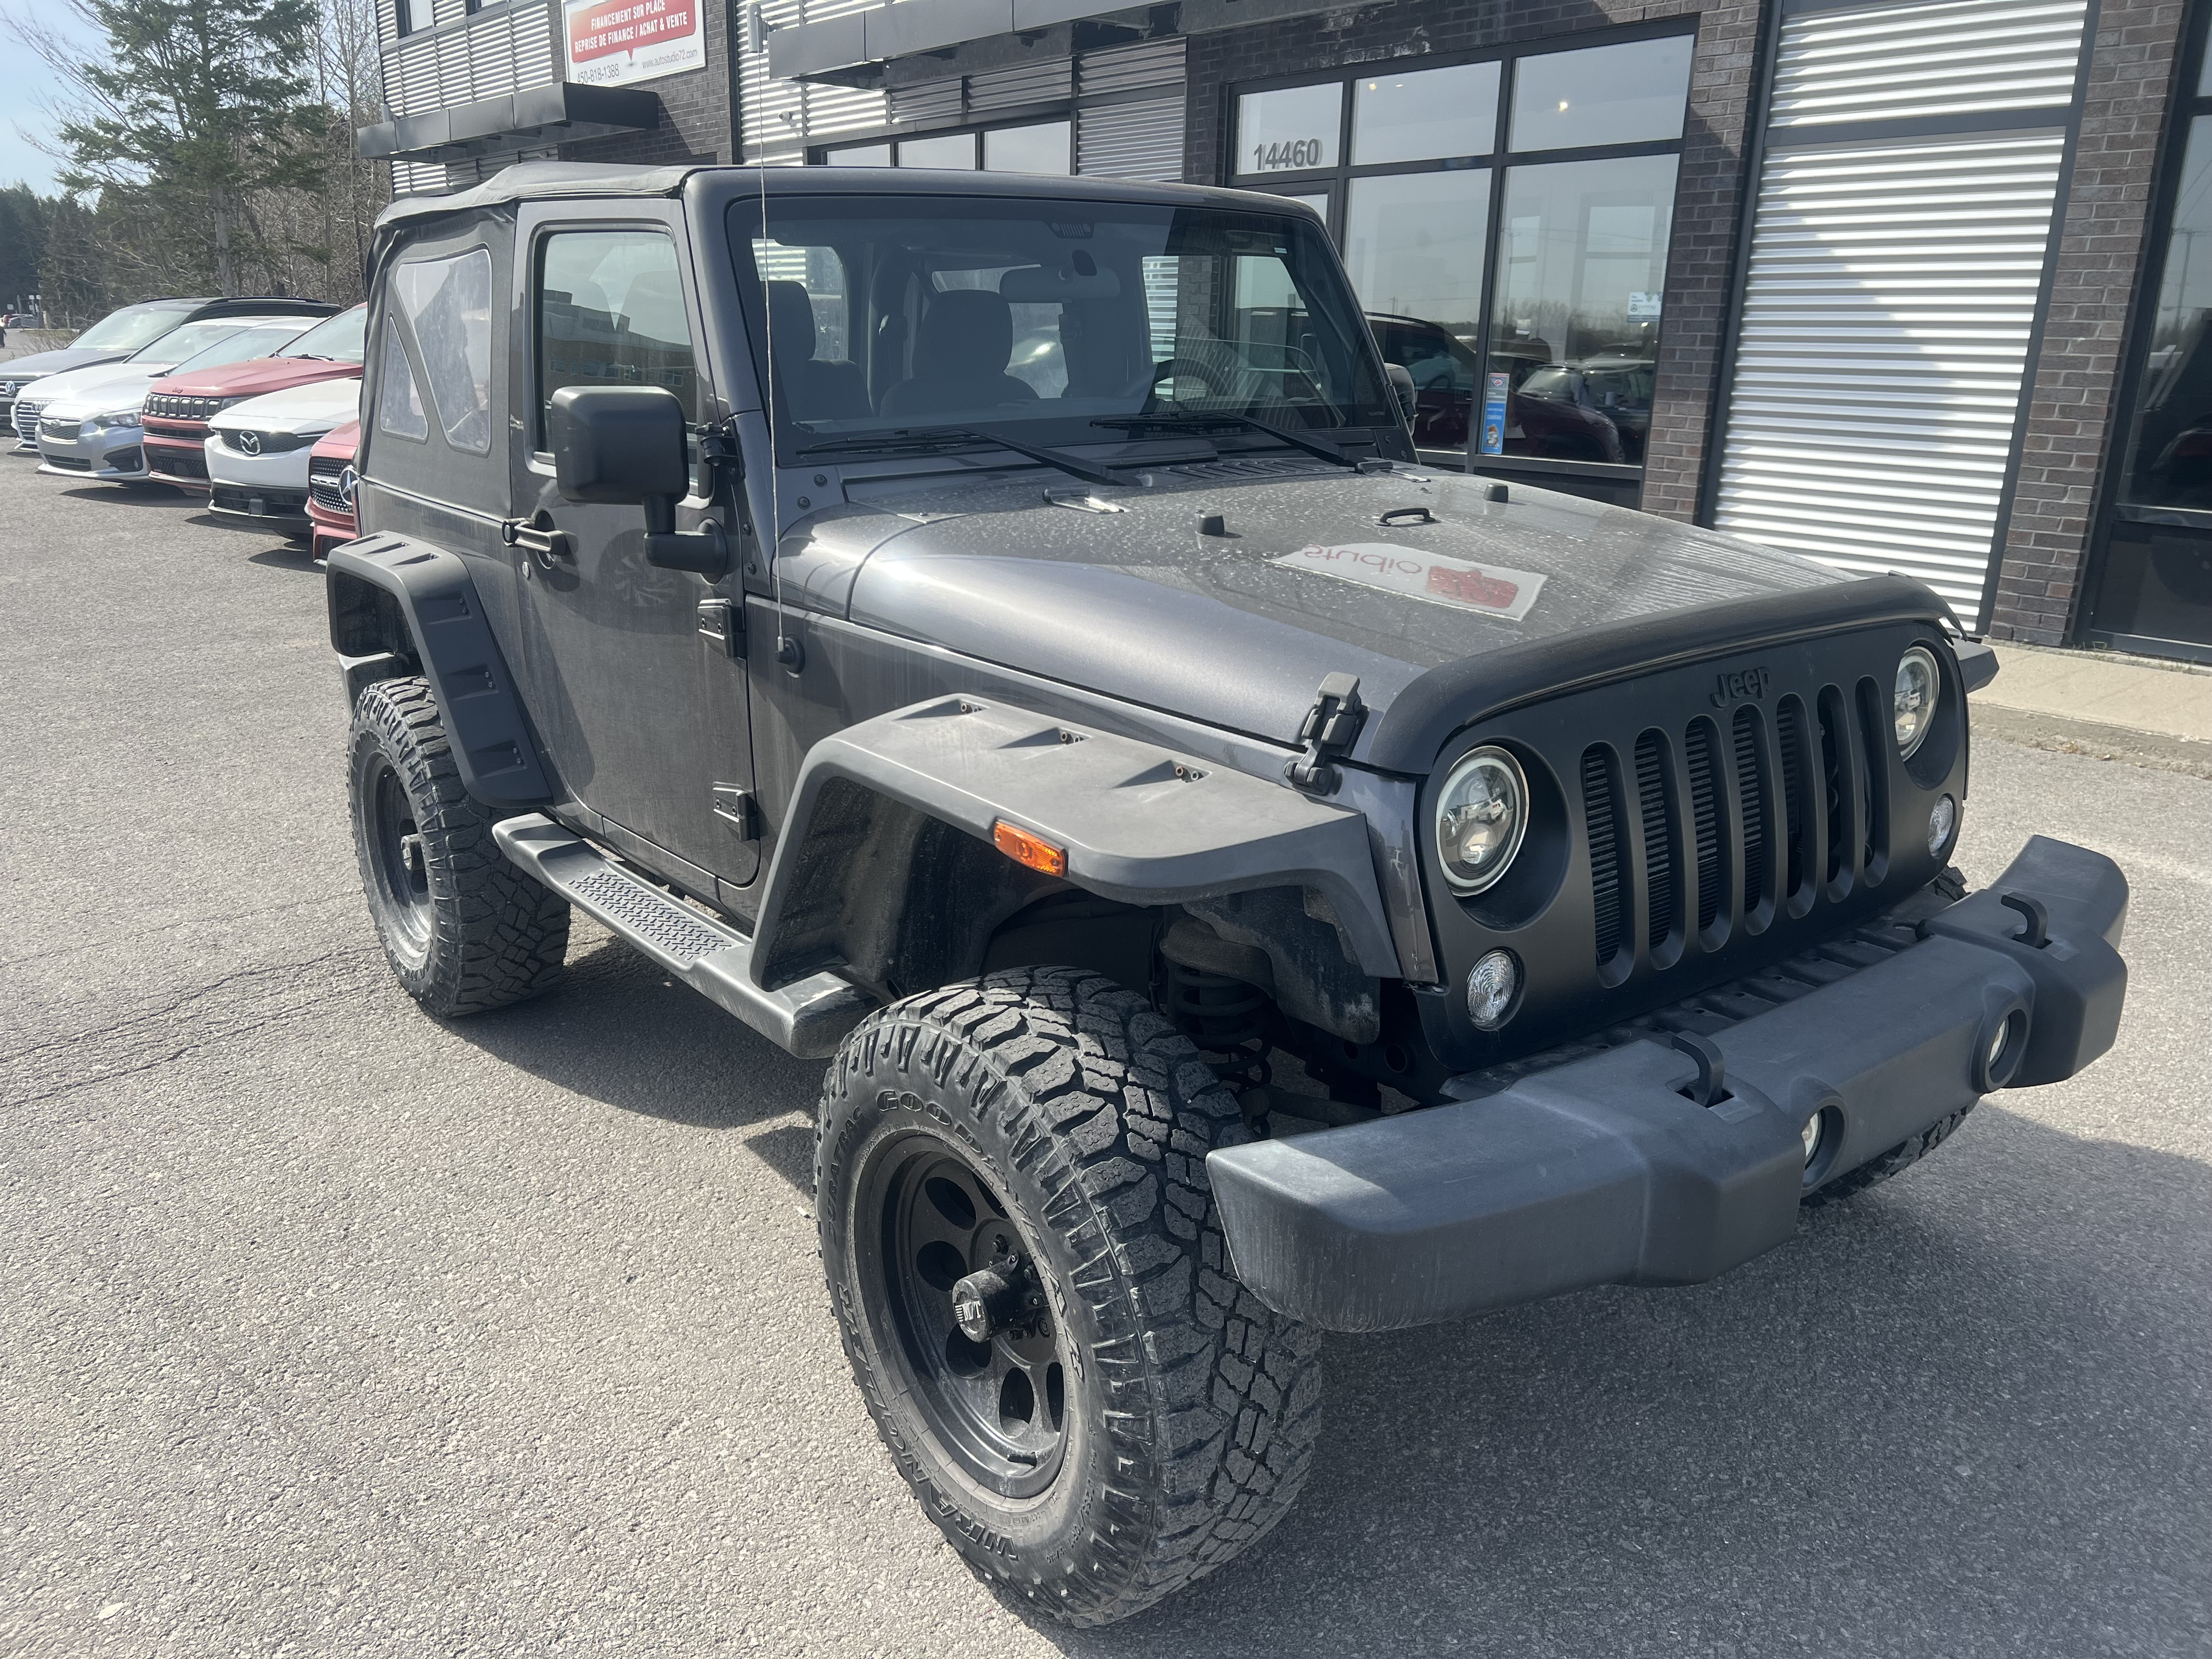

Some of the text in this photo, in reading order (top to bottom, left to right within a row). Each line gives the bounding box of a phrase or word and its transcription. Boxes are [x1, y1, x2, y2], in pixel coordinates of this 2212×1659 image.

[574, 36, 597, 53] REPRISE
[599, 33, 607, 47] DE
[607, 26, 634, 45] FINANCE
[639, 19, 658, 37] ACHAT
[659, 17, 665, 31] &
[665, 11, 687, 29] VENTE
[591, 0, 665, 31] FINANCEMENT SUR PLACE
[577, 64, 619, 84] 450-818-1388
[642, 49, 698, 69] www.autostudio72.com
[1254, 138, 1320, 171] 14460
[1710, 666, 1773, 709] Jeep
[827, 1105, 863, 1246] DURATRAC
[836, 1282, 1019, 1560] WRANGLER
